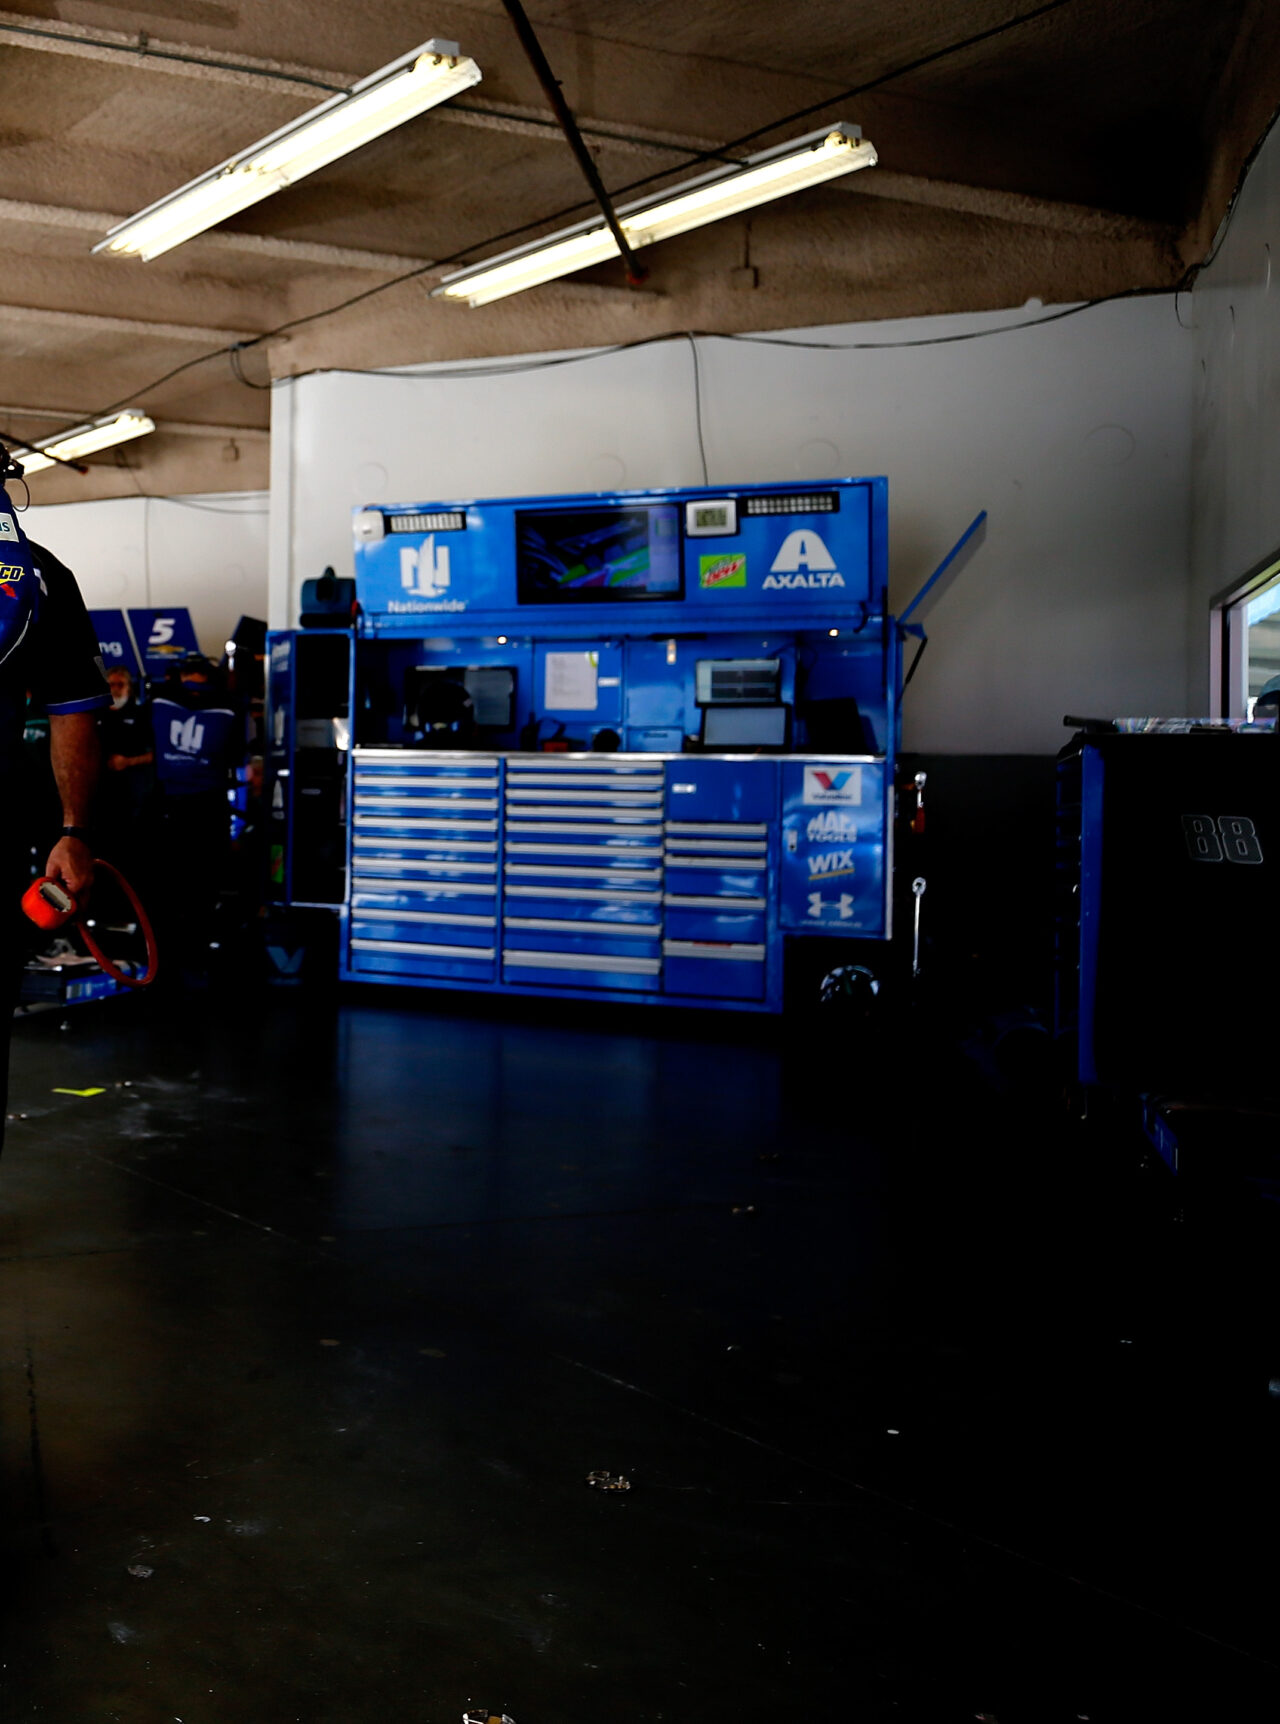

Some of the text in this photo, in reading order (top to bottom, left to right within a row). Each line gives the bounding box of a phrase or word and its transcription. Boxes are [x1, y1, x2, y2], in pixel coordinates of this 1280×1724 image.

[762, 572, 846, 591] AXALTA
[387, 598, 469, 615] Nationwide
[148, 618, 176, 645] 5
[1181, 814, 1265, 865] 88
[808, 849, 854, 875] WIX
